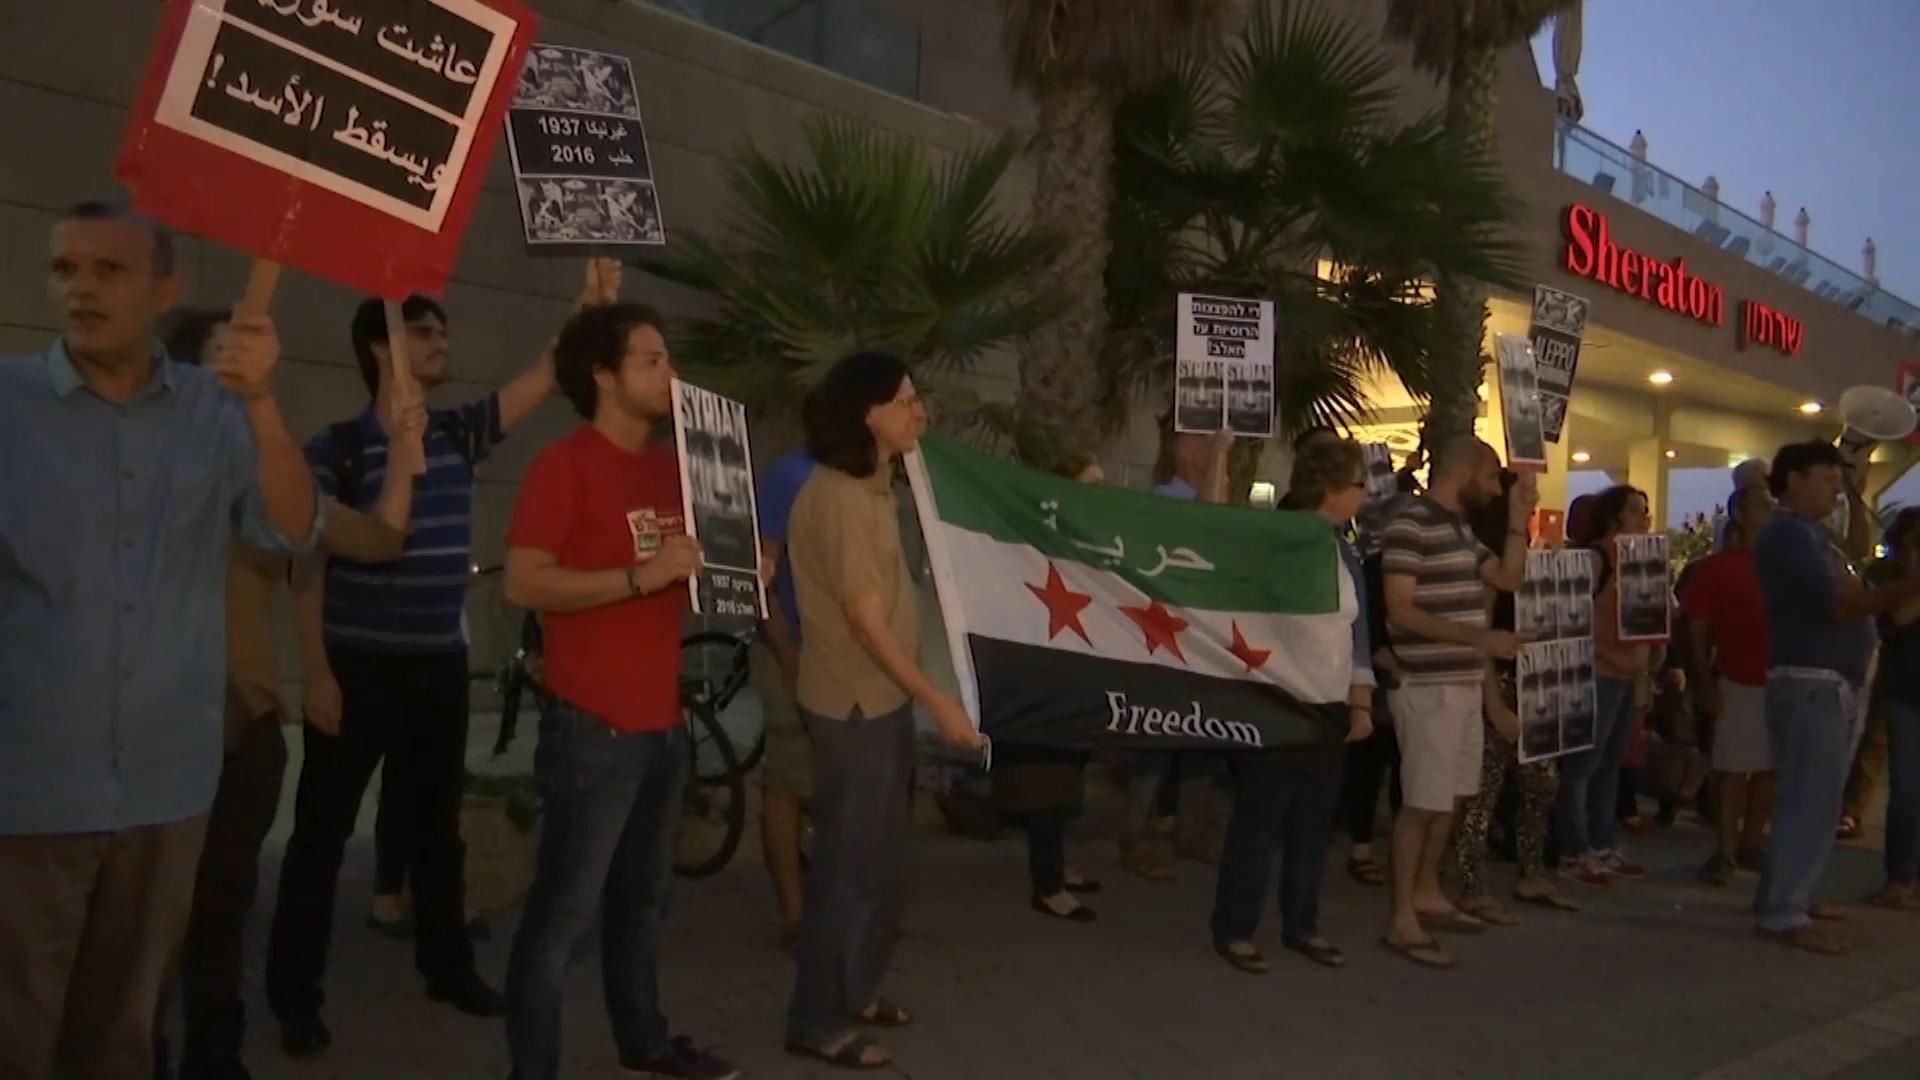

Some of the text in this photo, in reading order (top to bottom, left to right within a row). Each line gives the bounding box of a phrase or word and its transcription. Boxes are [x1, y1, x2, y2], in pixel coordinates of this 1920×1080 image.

[376, 24, 479, 84] عاشت
[333, 105, 449, 190] ويسقط
[538, 115, 581, 136] 1937
[551, 144, 634, 167] حلب 2016
[1567, 203, 1726, 328] Sheraton
[1746, 300, 1804, 356] שרתון
[1040, 501, 1215, 578] حرية
[1105, 690, 1263, 748] Freedom
